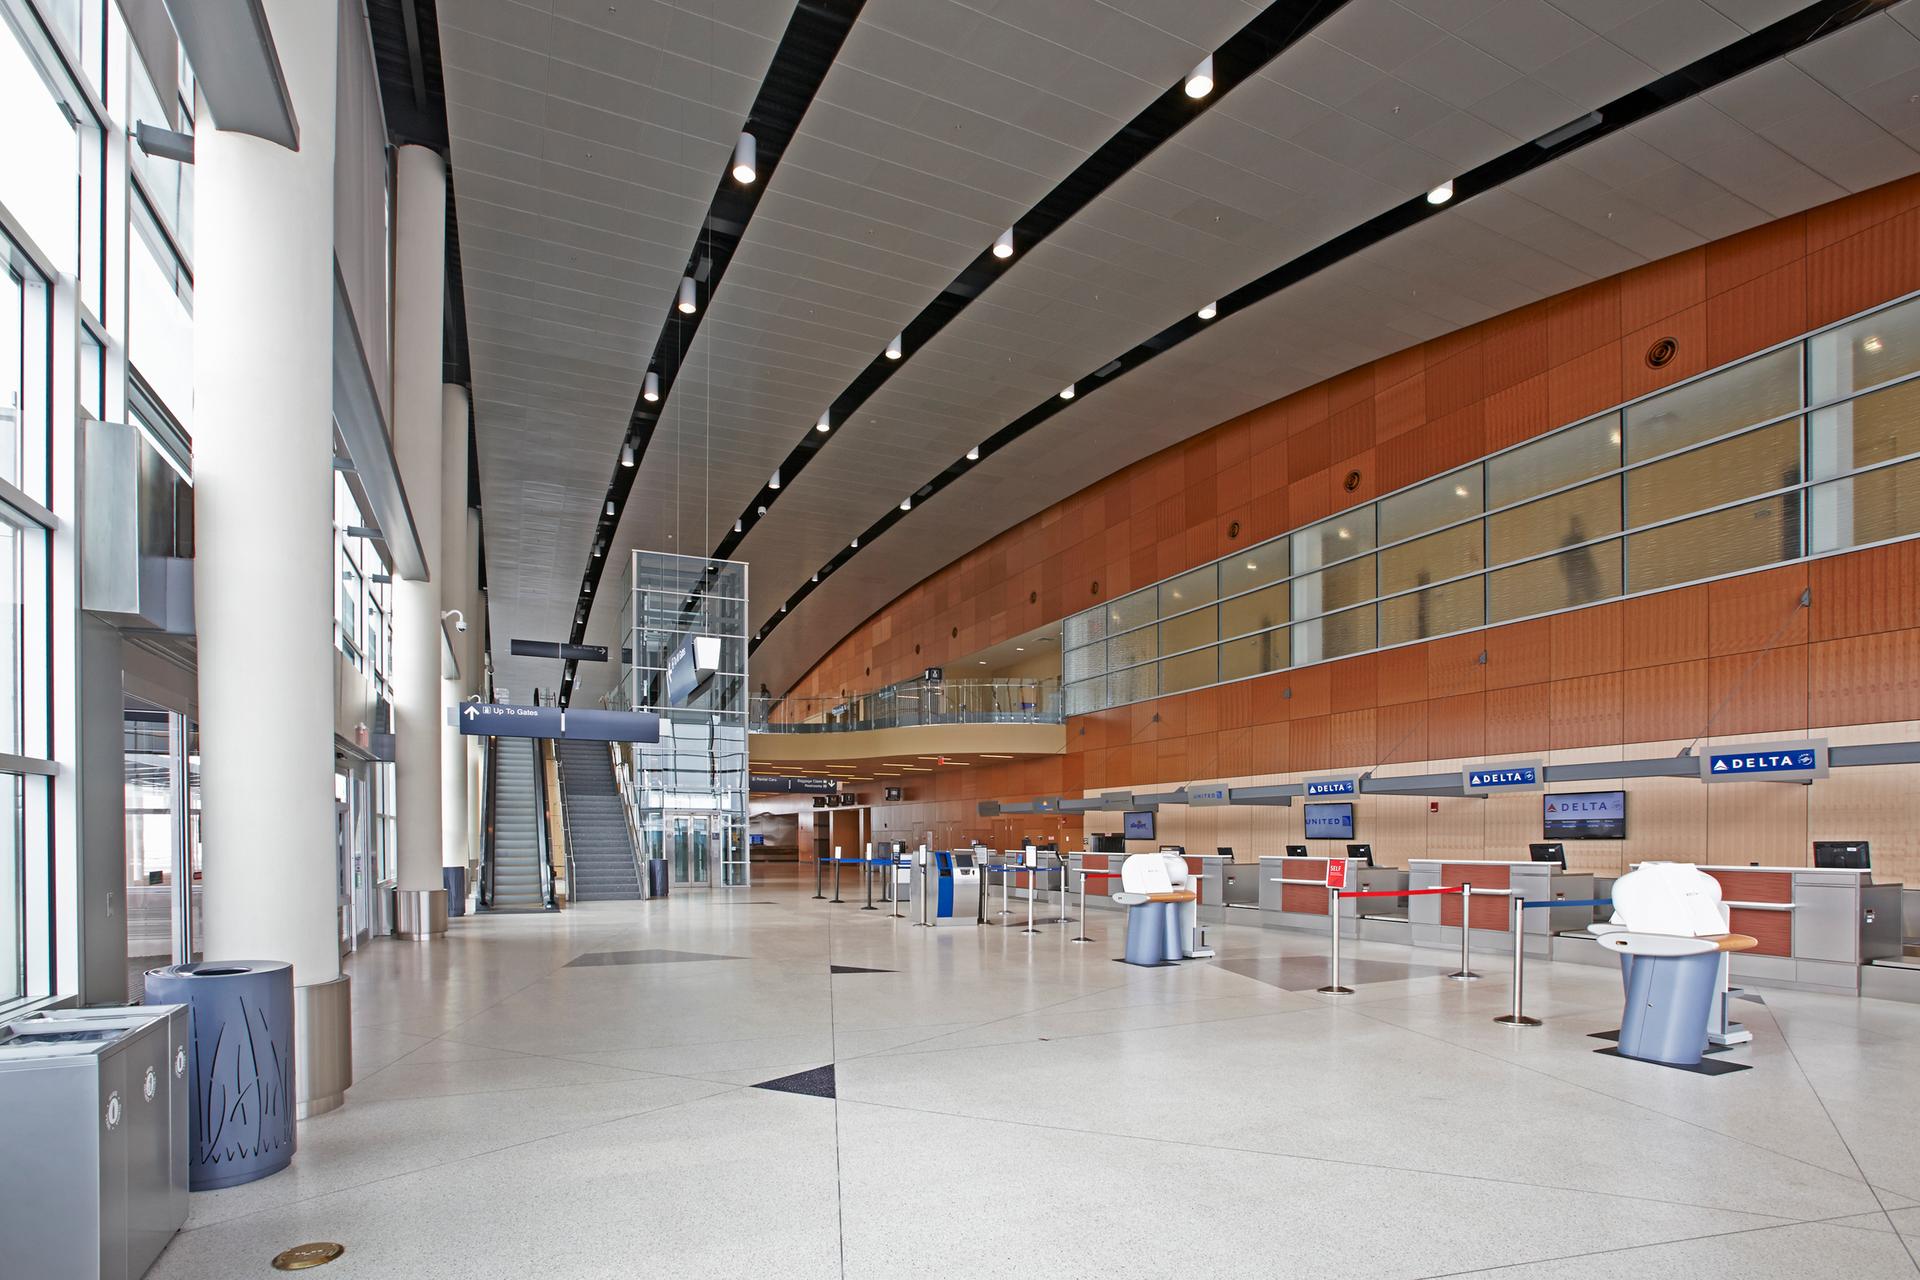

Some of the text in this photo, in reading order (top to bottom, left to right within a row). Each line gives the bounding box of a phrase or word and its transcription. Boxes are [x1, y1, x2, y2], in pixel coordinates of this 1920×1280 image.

[493, 707, 504, 715] Up
[516, 708, 538, 716] Gates
[1732, 755, 1793, 769] DELTA
[1483, 772, 1522, 783] DELTA
[1317, 784, 1345, 793] DELTA
[1561, 801, 1607, 812] DELTA
